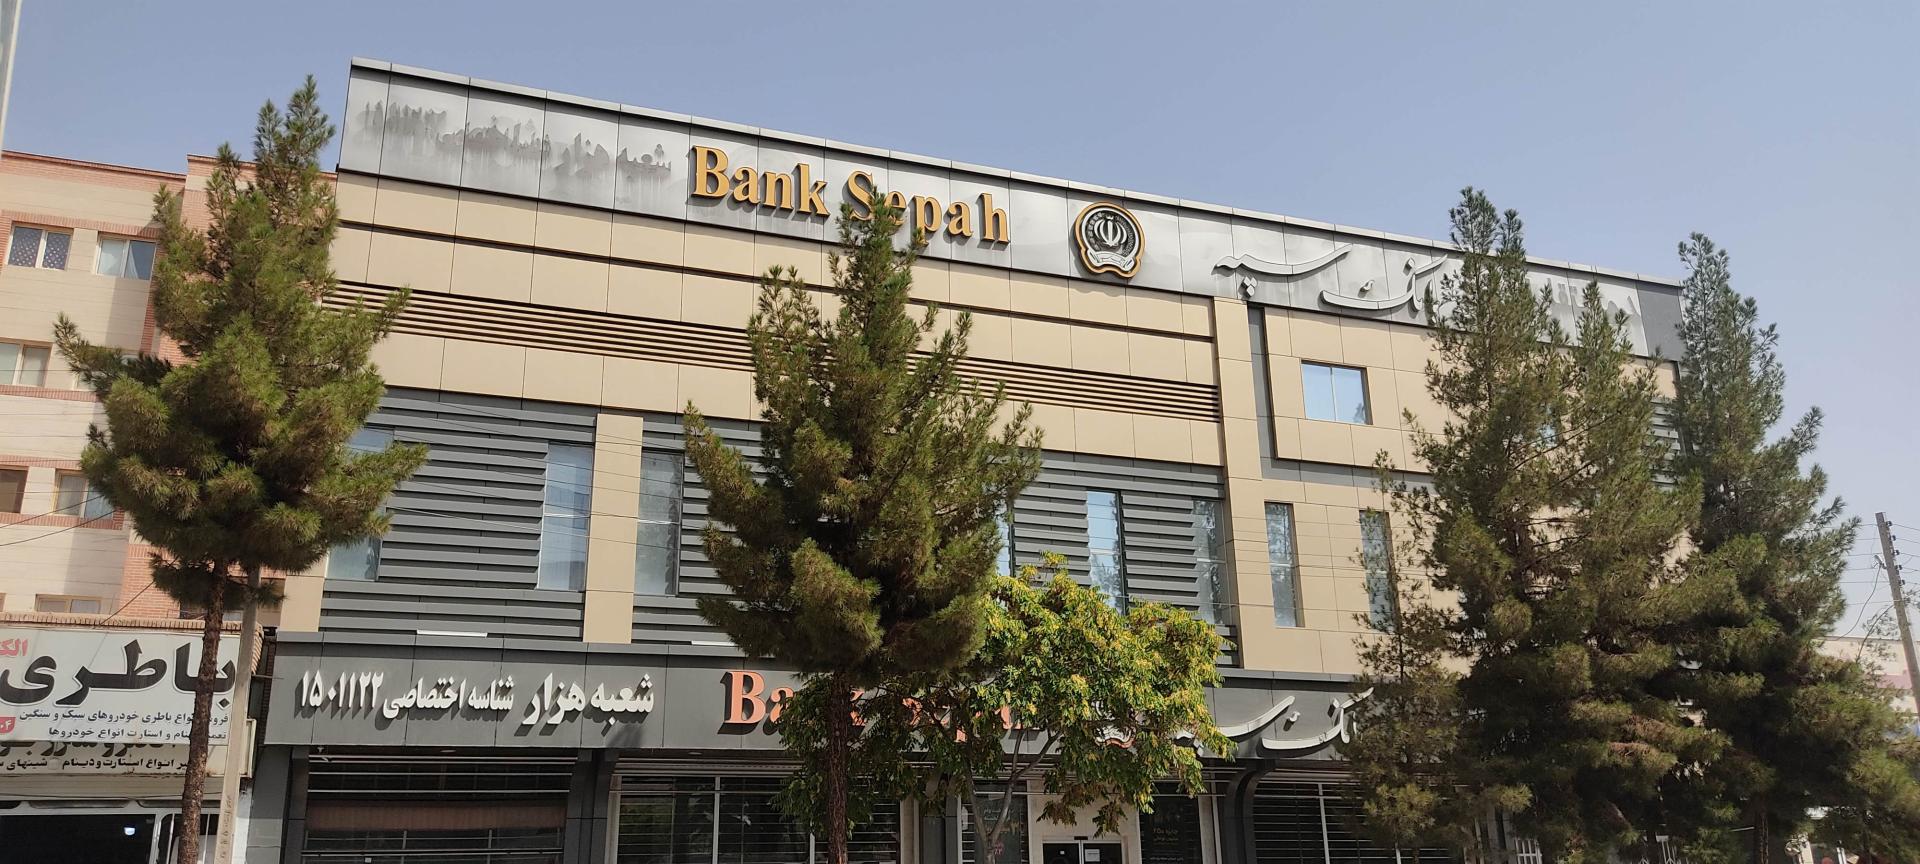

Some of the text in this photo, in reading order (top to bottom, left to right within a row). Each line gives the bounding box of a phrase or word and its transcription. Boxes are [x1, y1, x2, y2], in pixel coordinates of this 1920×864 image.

[692, 145, 830, 216] Bank
[847, 170, 1010, 246] Sepah
[0, 639, 236, 709] باطری
[301, 670, 655, 726] شعبه هزار شناسه اختصاصی ۱۵۰۱۱۲۲
[19, 708, 50, 721] سنگین
[62, 709, 84, 720] سبک
[88, 710, 139, 724] خودروهای
[141, 711, 172, 725] باطری
[48, 727, 94, 737] خودروها
[98, 729, 124, 738] انواع
[127, 729, 162, 740] استارت
[103, 757, 143, 769] استارت
[145, 758, 174, 769] انواع
